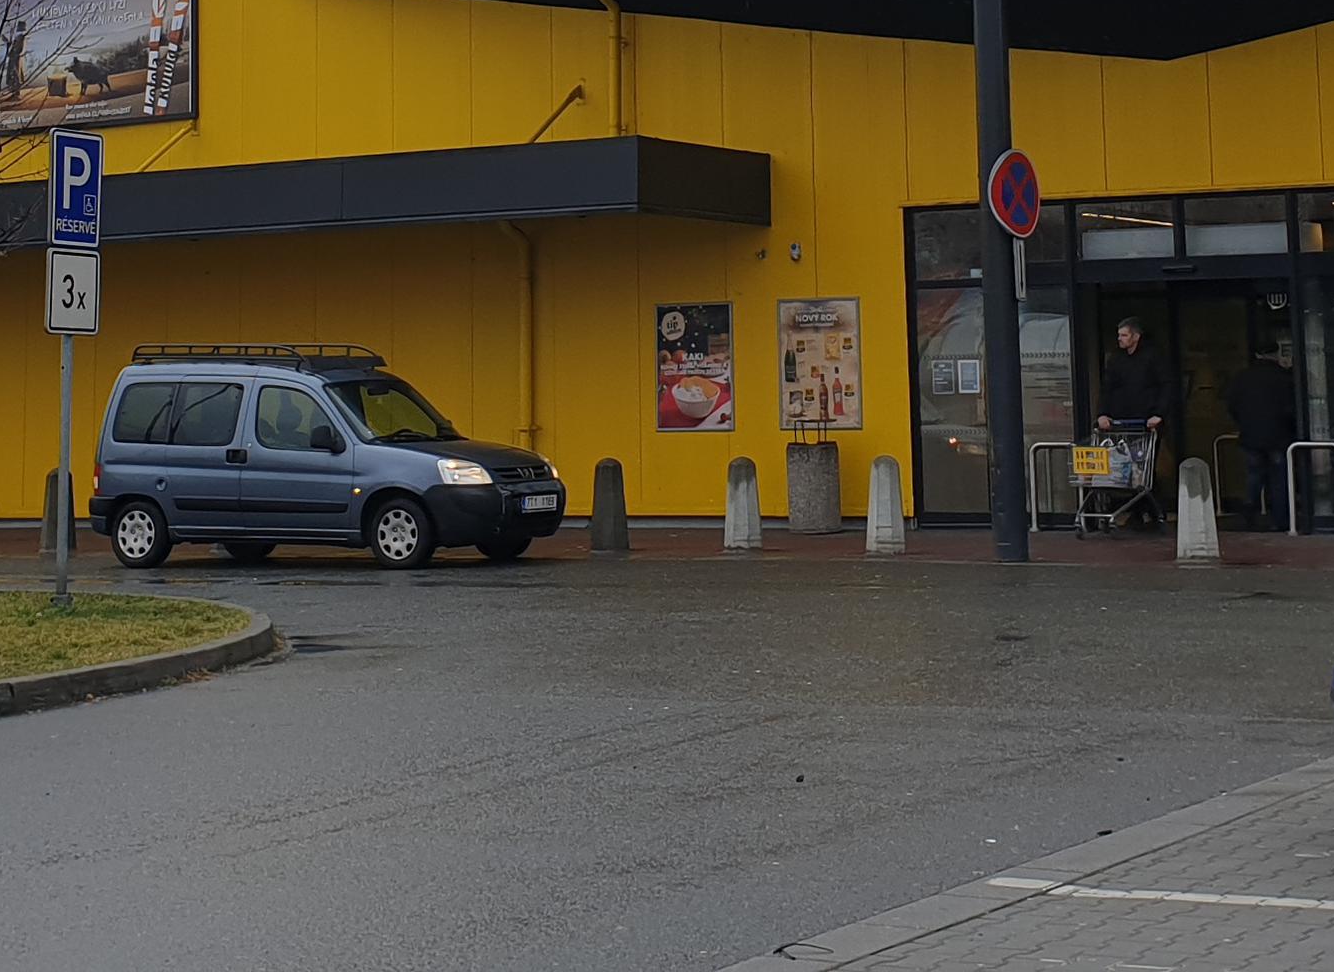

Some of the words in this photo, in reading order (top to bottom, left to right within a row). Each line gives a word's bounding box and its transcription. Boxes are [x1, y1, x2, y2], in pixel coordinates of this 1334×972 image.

[63, 146, 91, 209] P
[56, 215, 97, 235] RÉSERVÉ
[62, 274, 87, 310] 3x
